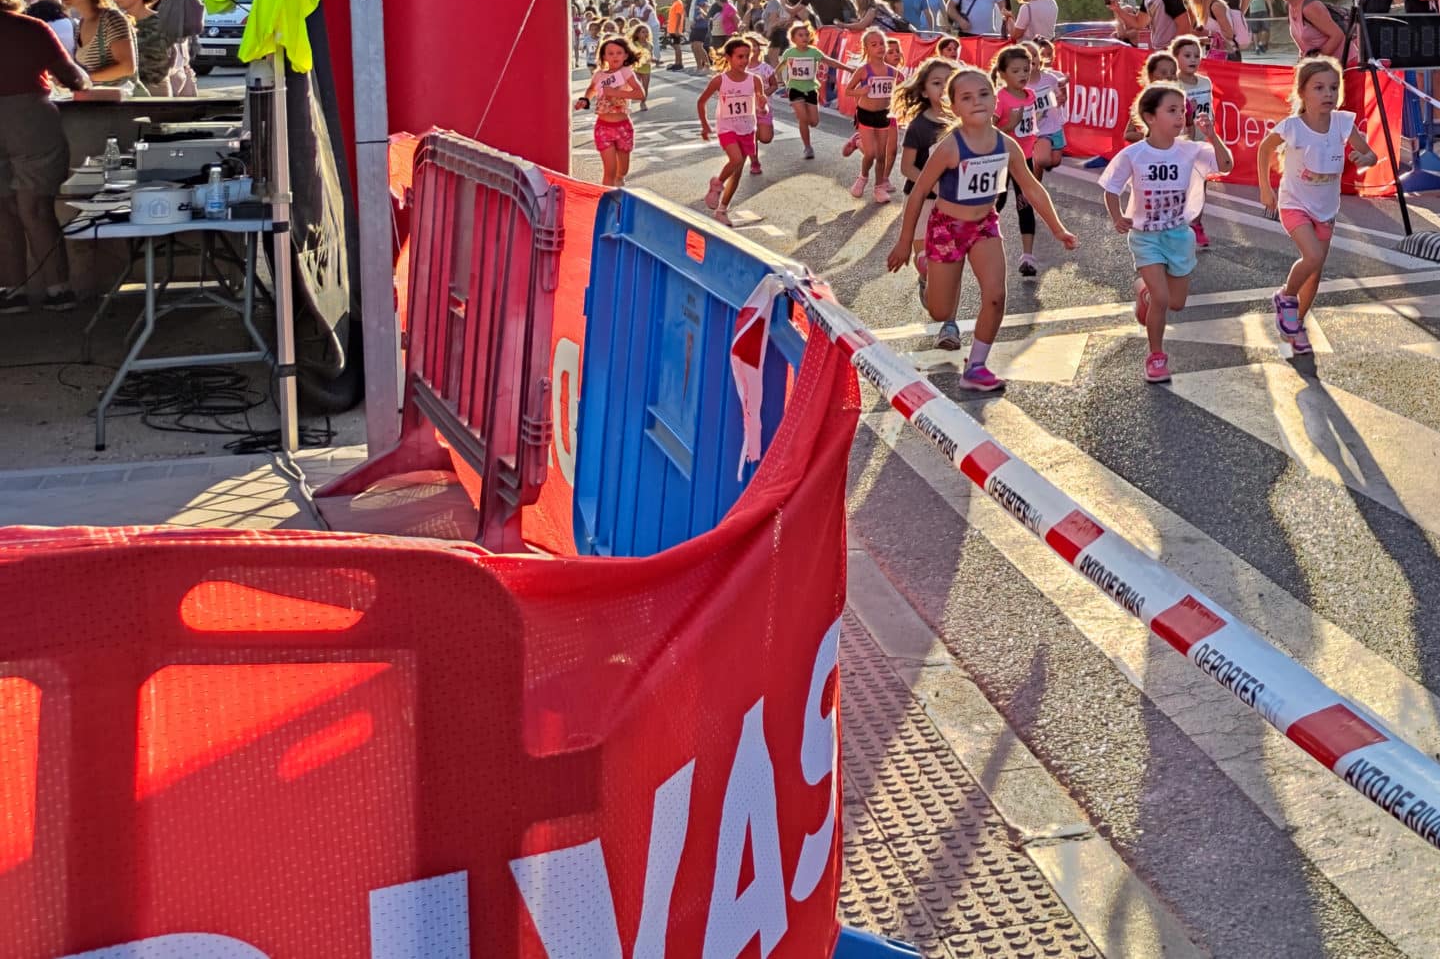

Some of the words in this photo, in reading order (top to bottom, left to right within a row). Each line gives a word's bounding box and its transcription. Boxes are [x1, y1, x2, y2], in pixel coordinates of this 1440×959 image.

[791, 66, 810, 77] 854
[871, 83, 893, 95] 1169
[727, 101, 748, 115] 131
[967, 170, 999, 194] 461
[1148, 164, 1178, 181] 303
[988, 475, 1031, 525] DEPORTES
[1114, 582, 1146, 618] RIVAS
[1194, 643, 1265, 708] DEPORTES
